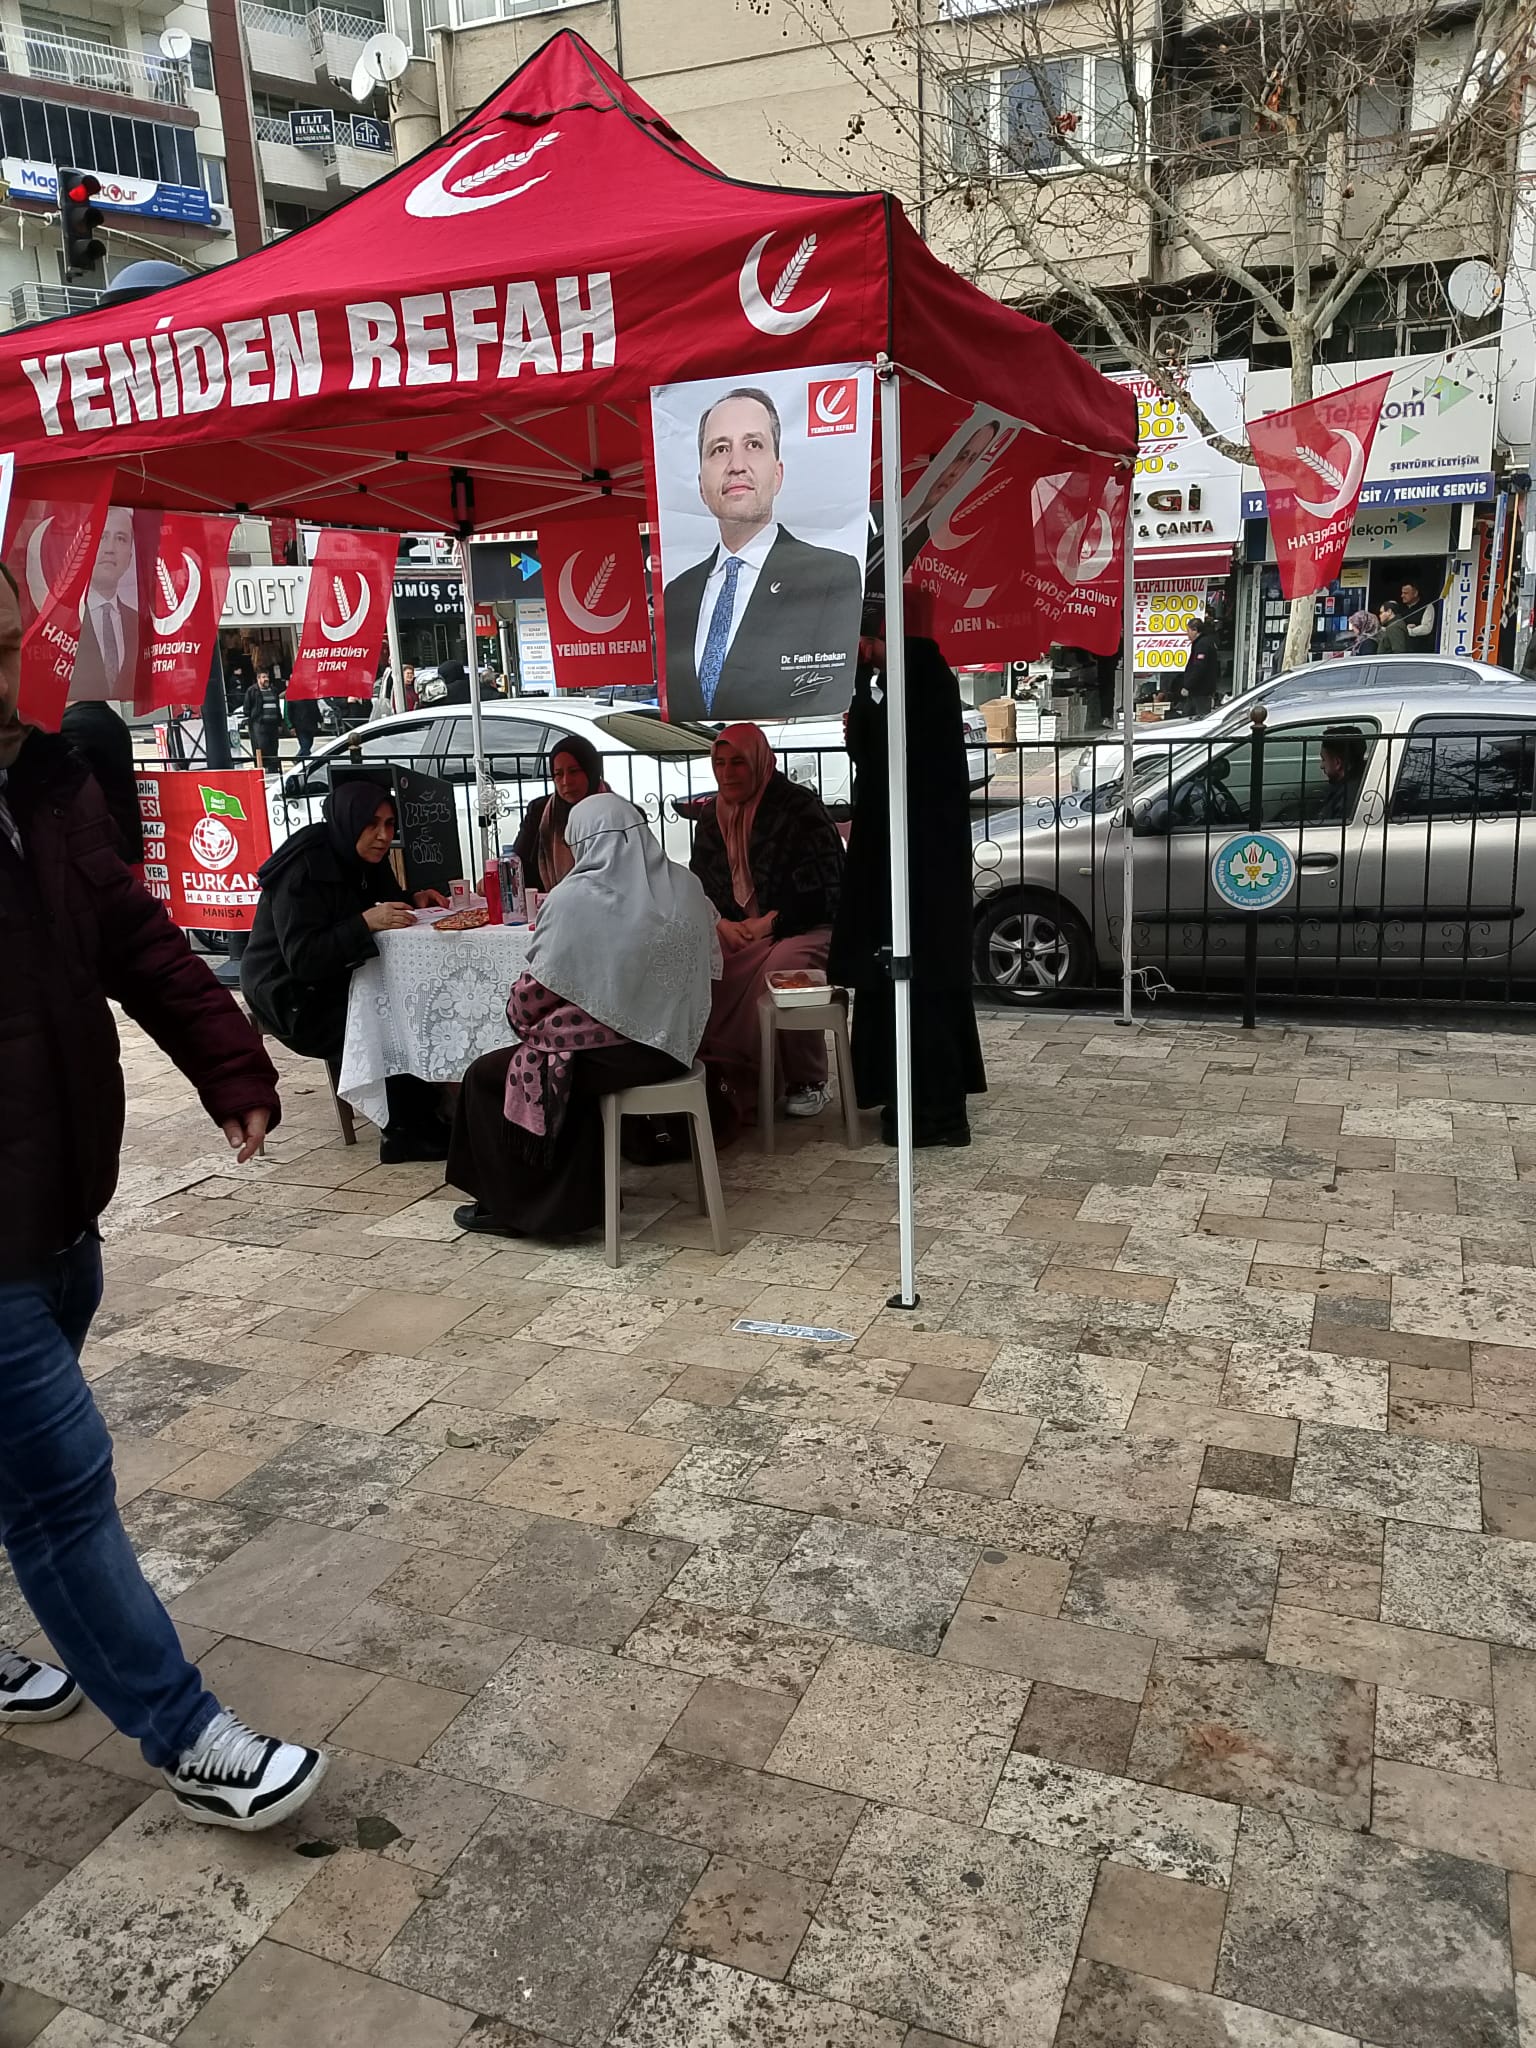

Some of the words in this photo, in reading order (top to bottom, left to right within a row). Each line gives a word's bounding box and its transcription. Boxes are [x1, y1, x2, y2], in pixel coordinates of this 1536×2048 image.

[295, 124, 331, 134] HUKUK
[100, 184, 137, 201] tour
[21, 315, 323, 436] YENİDEN
[346, 271, 615, 390] REFAH
[1390, 459, 1434, 472] ŞENTÜRK
[1248, 499, 1263, 512] 12
[1393, 482, 1440, 500] TEKNİK
[1443, 479, 1487, 497] SERVİS
[1138, 525, 1149, 537] &
[1156, 520, 1213, 538] ÇANTA
[1352, 524, 1398, 537] lekom
[393, 581, 441, 600] ÜMÜŞ
[447, 583, 465, 600] ÇE
[1457, 563, 1472, 623] Türk
[1150, 595, 1198, 612] 500
[556, 640, 605, 657] YENİDEN
[608, 640, 647, 654] REFAH
[793, 653, 813, 663] Fatih
[815, 652, 846, 662] Erbakan
[1135, 650, 1187, 667] 1000
[137, 780, 157, 795] RİH:
[141, 797, 162, 817] ESİ
[143, 824, 163, 836] AAT:
[146, 866, 167, 878] YER:
[182, 872, 260, 890] FURKAN
[203, 907, 244, 918] MANİSA
